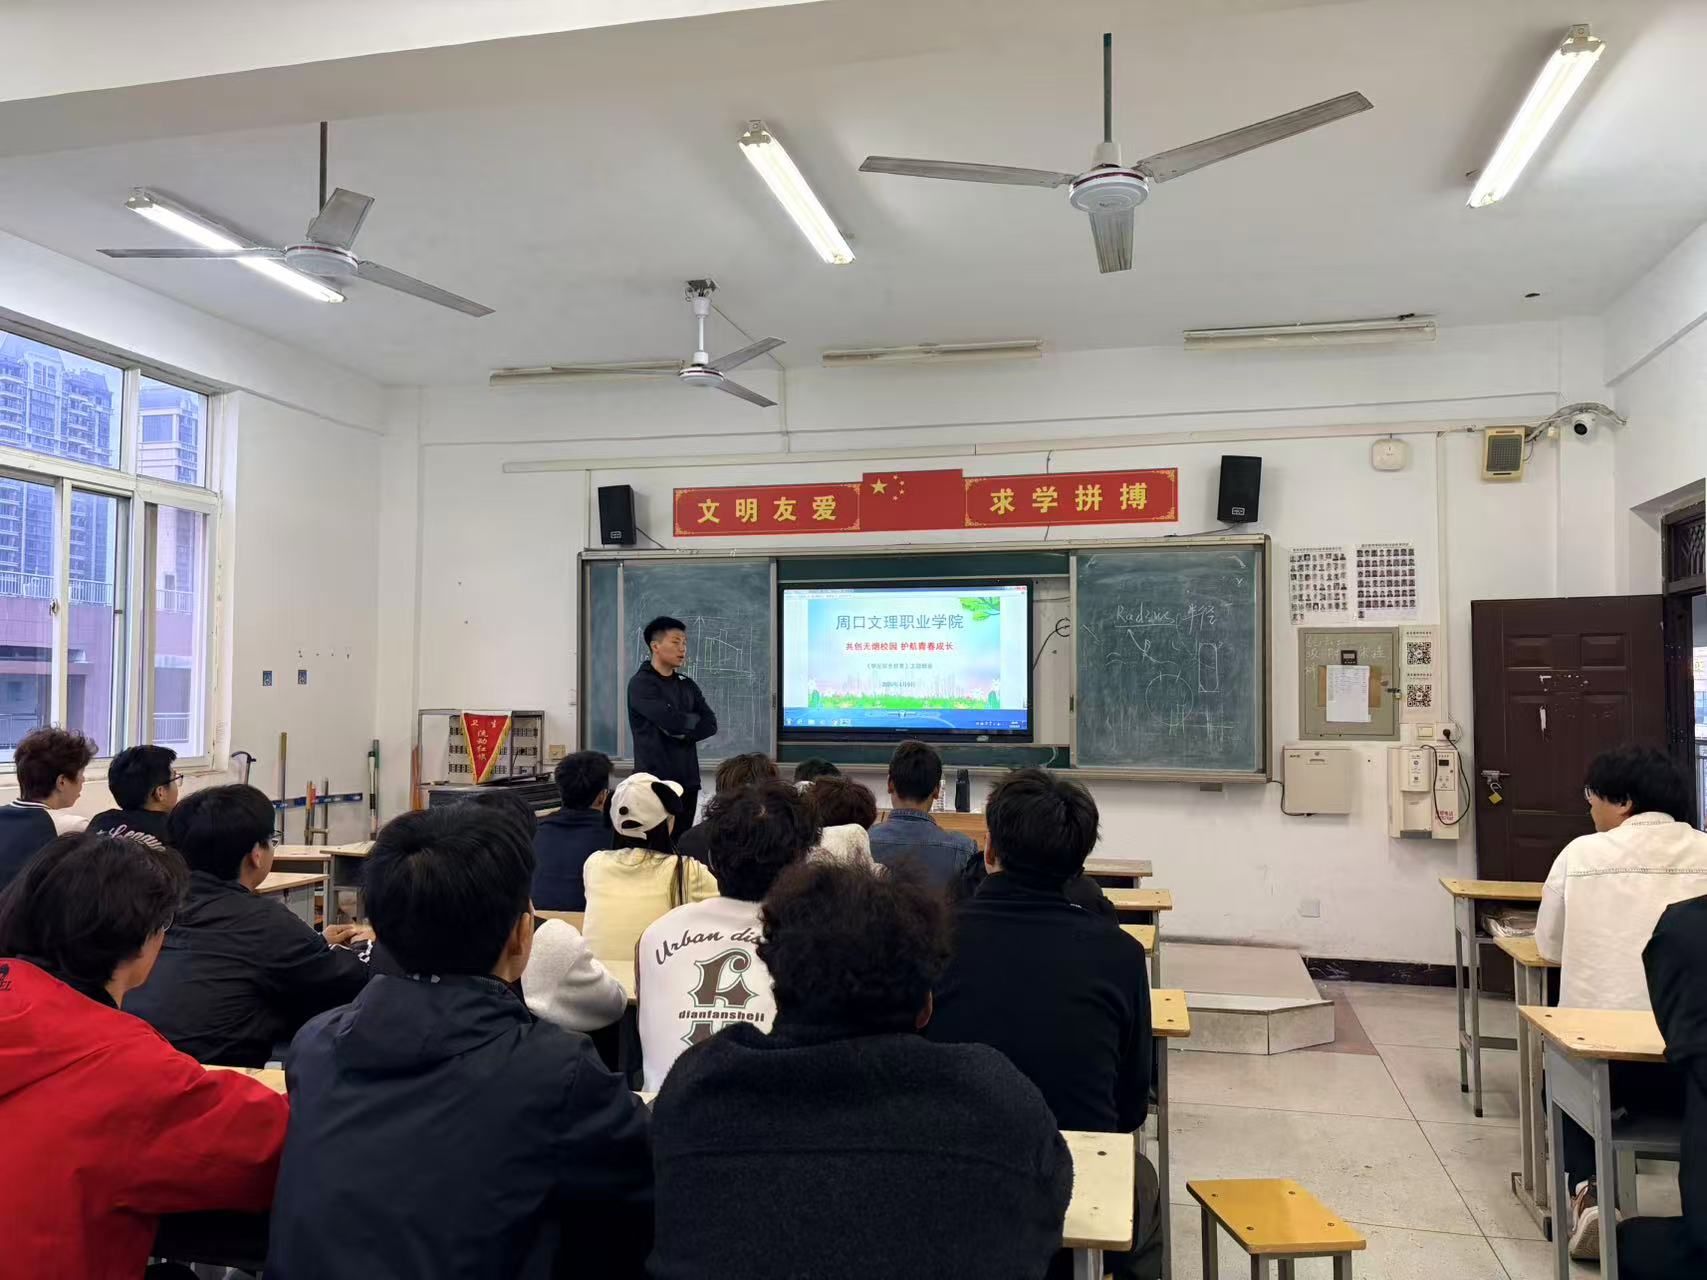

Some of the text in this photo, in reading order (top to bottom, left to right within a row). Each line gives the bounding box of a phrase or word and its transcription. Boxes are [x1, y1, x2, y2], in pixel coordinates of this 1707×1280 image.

[697, 494, 837, 525] 文明友爱
[989, 482, 1148, 516] 求学拼搏
[835, 614, 964, 630] 周口文理职业学院
[846, 641, 953, 651] 共创无烟校园 护航青春成长
[656, 929, 724, 965] Urban
